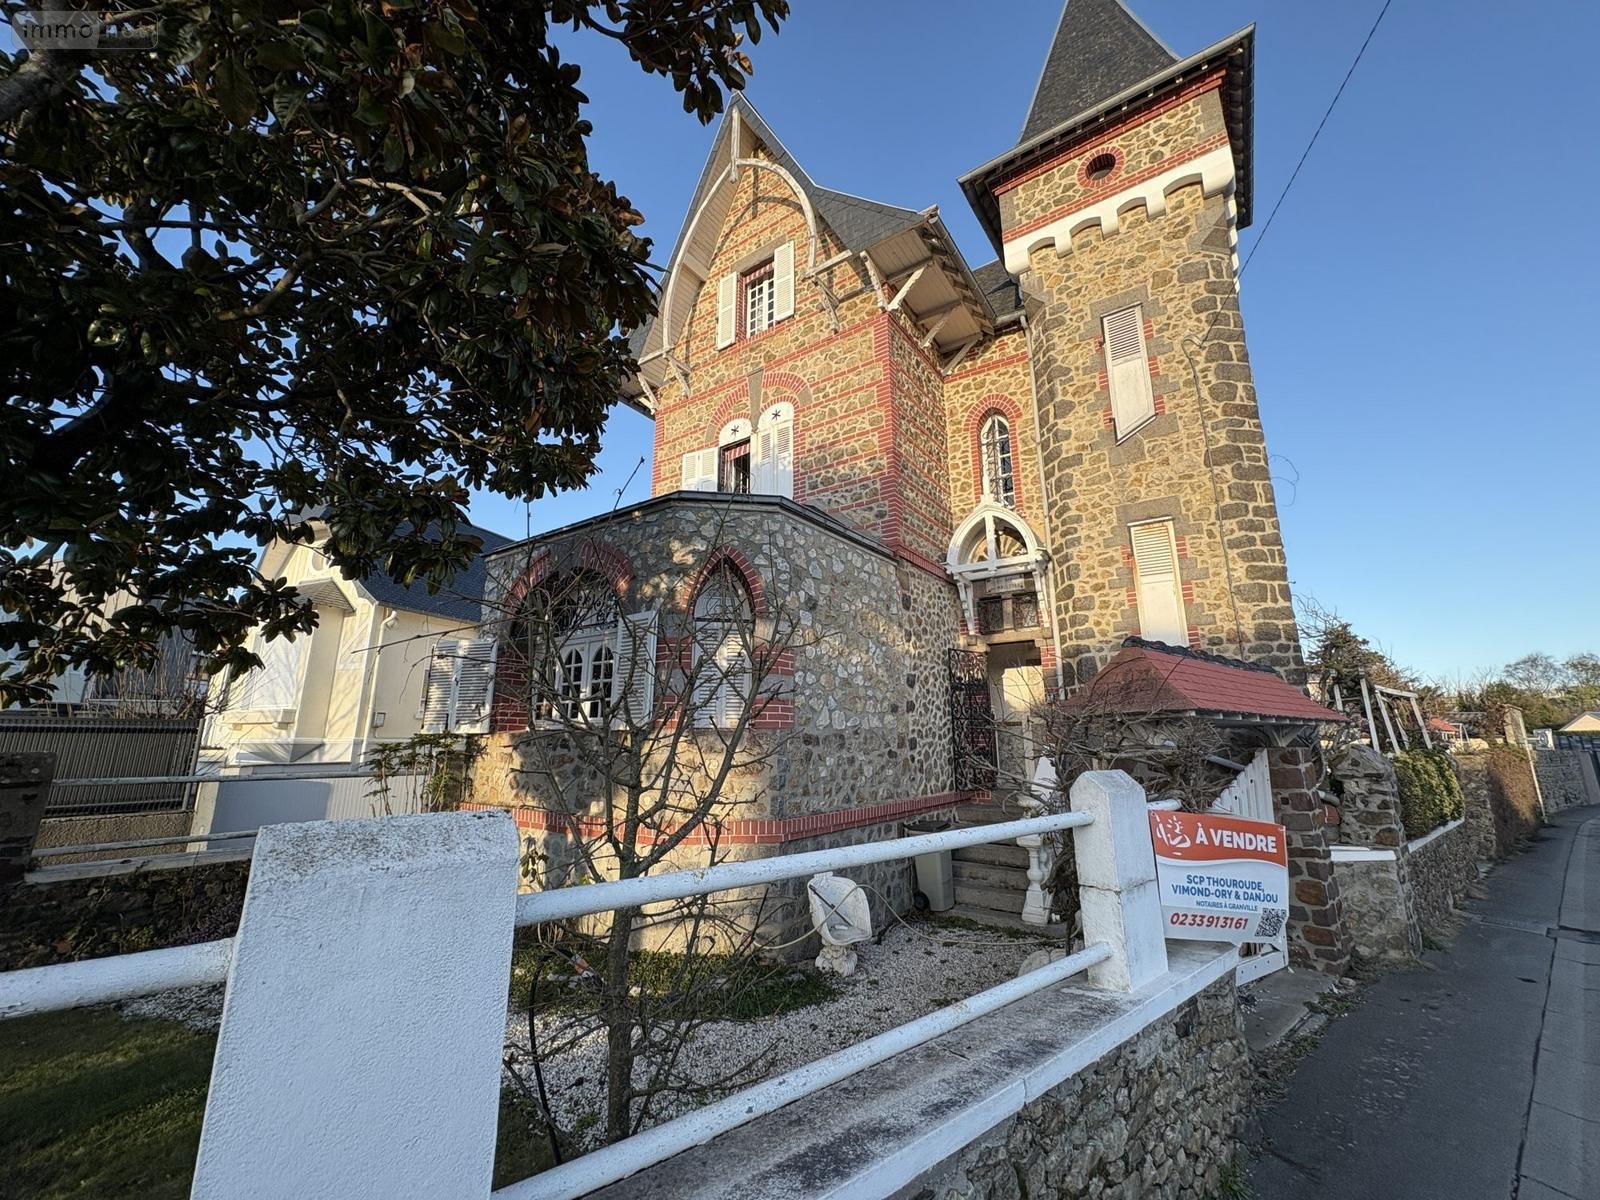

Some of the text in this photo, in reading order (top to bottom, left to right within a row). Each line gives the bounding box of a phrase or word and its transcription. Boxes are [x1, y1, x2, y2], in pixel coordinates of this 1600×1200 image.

[1195, 822, 1277, 853] À VENDRE
[1186, 874, 1264, 892] SCP THOUROUDE,
[1172, 884, 1278, 903] VIMOND-ORY & DANJOU
[1196, 900, 1259, 912] NOTAIRES À GRANVILLE
